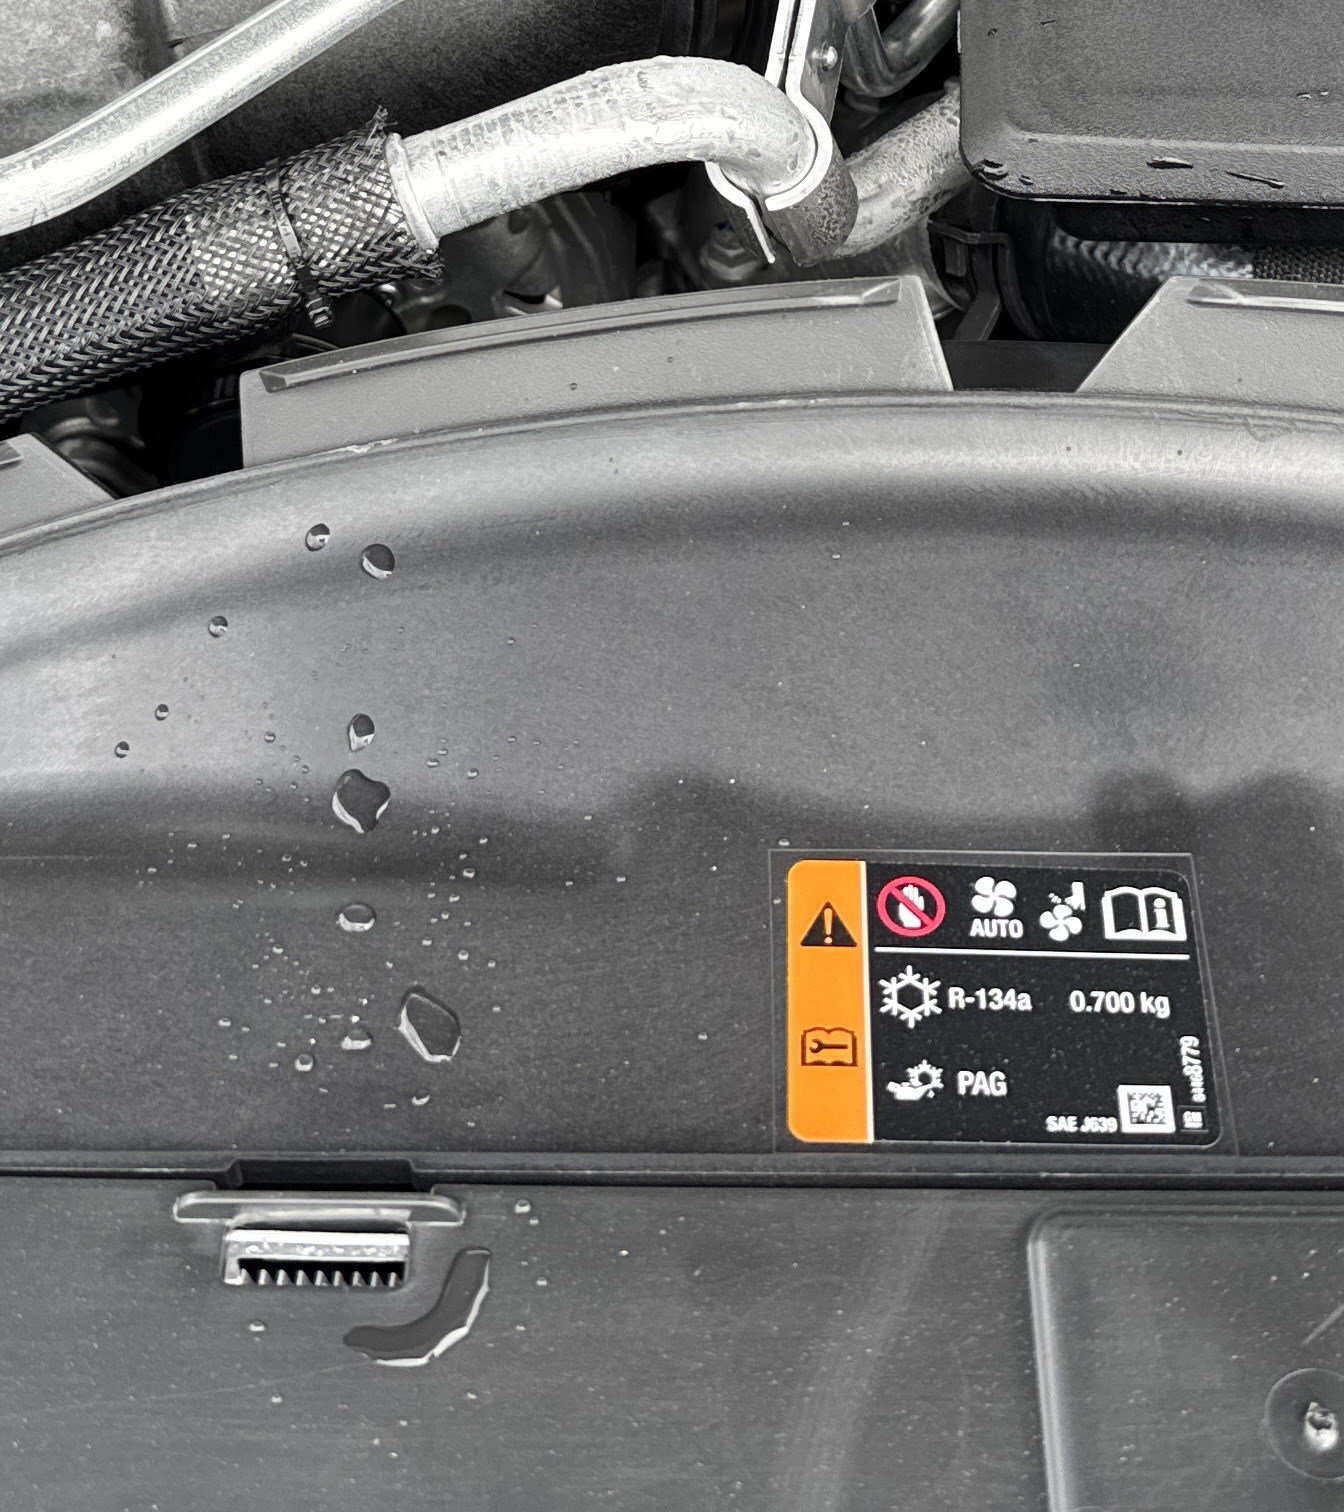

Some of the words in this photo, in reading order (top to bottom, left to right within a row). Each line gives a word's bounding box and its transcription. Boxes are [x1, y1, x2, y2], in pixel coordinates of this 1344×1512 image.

[970, 918, 1024, 938] AUTO
[948, 987, 1033, 1011] R-134a
[1069, 990, 1135, 1013] 0.700
[1140, 992, 1171, 1019] kg
[957, 1069, 1007, 1096] PAG
[1046, 1116, 1078, 1132] SAE
[1080, 1116, 1117, 1133] J639
